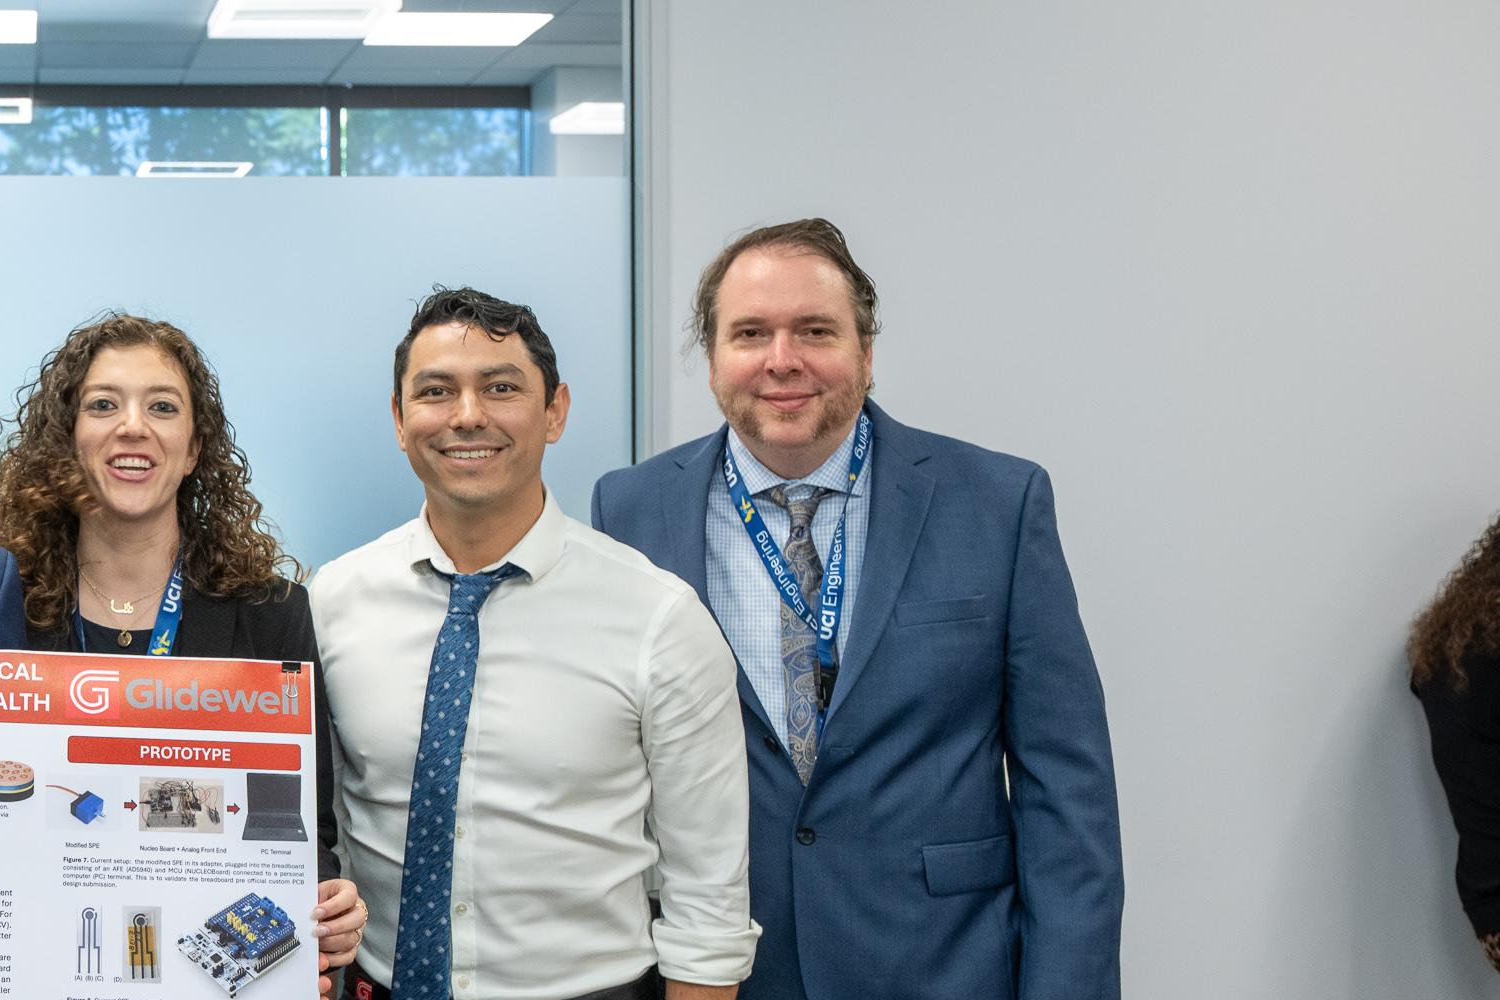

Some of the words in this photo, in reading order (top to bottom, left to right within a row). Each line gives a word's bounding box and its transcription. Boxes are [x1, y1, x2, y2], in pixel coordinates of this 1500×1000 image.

[854, 415, 869, 460] eering
[755, 530, 805, 617] Engineering
[163, 582, 182, 613] UCI
[804, 611, 818, 632] CI
[820, 610, 836, 641] UCI
[125, 678, 299, 716] Glidewell
[140, 745, 231, 761] PROTOTYPE
